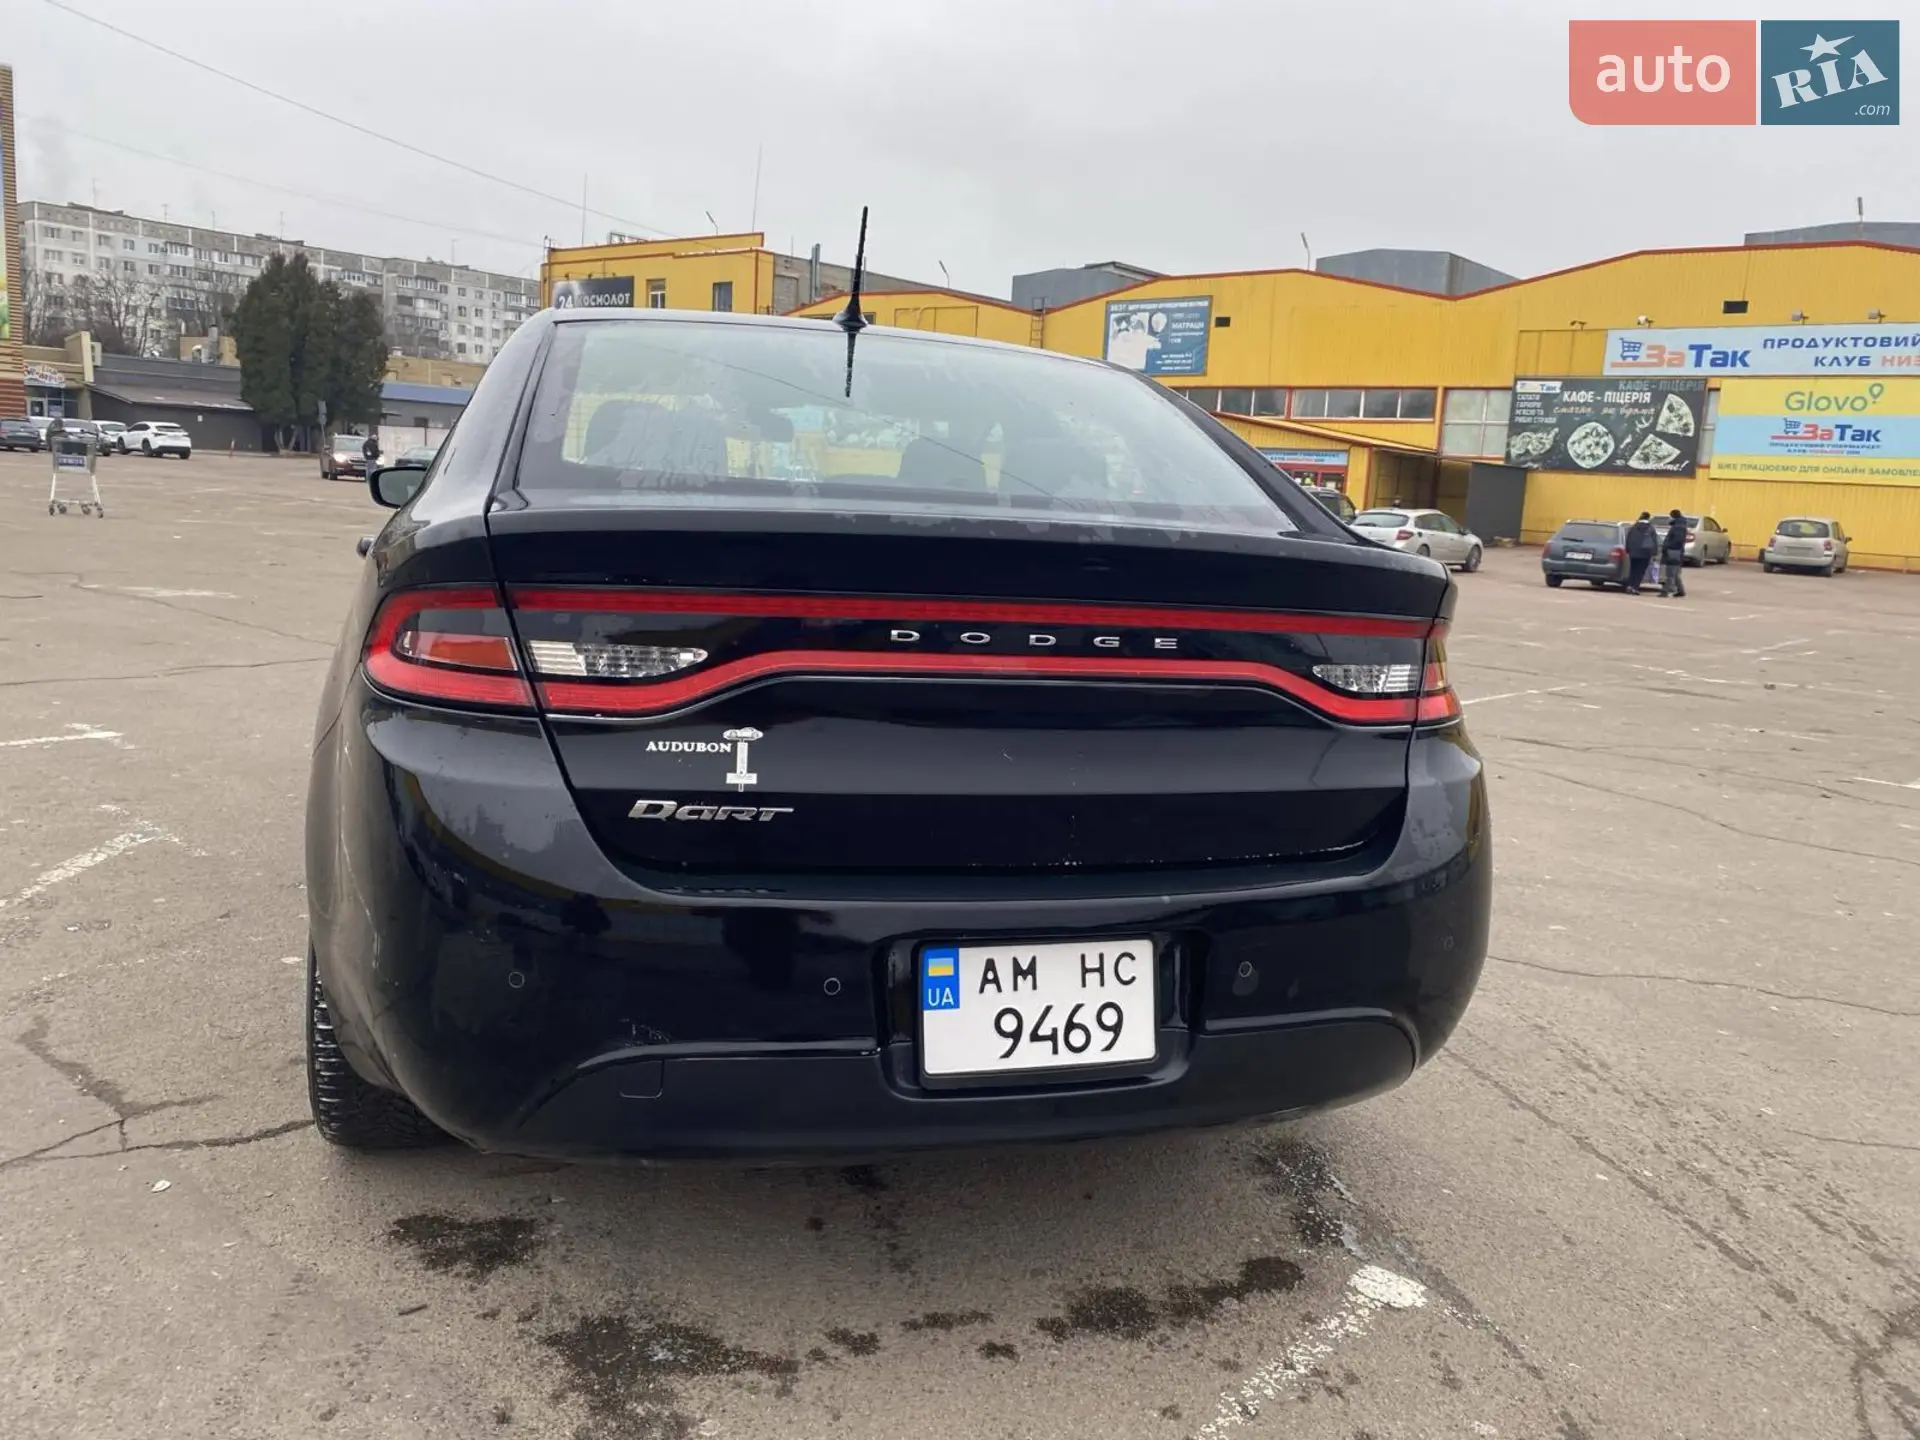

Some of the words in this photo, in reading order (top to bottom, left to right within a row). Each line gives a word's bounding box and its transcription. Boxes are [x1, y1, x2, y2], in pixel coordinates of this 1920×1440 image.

[1645, 344, 1752, 368] ЗаТак
[1814, 355, 1872, 367] КЛУБ
[1562, 391, 1594, 403] КАФЕ
[1604, 391, 1653, 405] ПІЦЕРІЯ
[1785, 391, 1868, 412] Glovo
[1802, 423, 1882, 442] ЗаТак
[890, 629, 1178, 649] DODGE
[646, 741, 732, 753] AUDUBON
[978, 955, 1037, 994] AM
[1080, 951, 1137, 988] HC
[928, 987, 954, 1006] UA
[994, 1001, 1124, 1059] 9469
